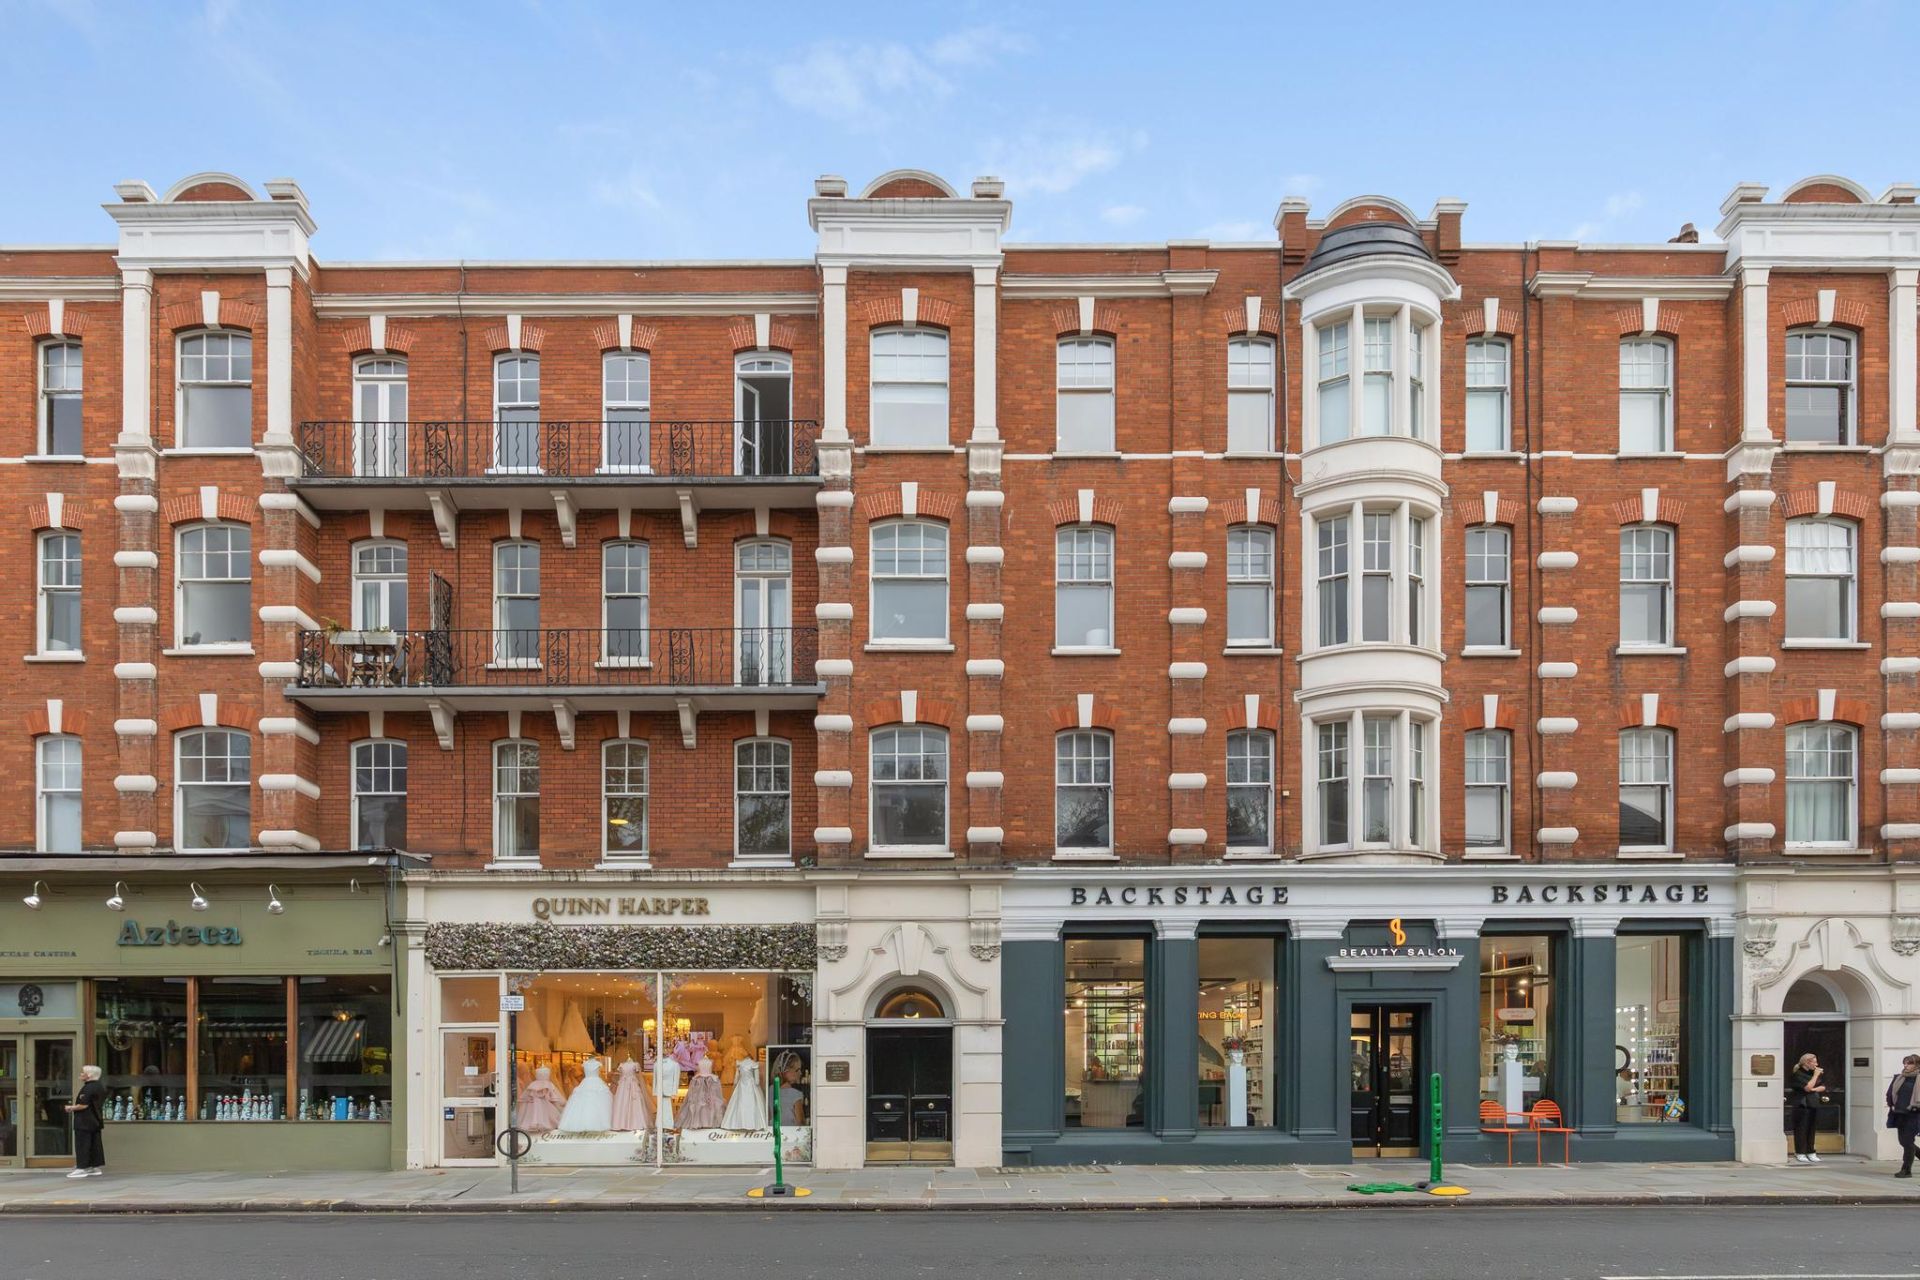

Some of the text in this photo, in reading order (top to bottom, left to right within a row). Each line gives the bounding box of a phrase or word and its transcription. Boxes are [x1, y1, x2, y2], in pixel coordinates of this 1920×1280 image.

[1071, 886, 1289, 905] BACKSTAGE
[1491, 884, 1709, 904] BACKSTAGE
[532, 897, 710, 920] QUINN HARPER
[116, 919, 243, 946] Azteca
[1339, 948, 1457, 957] BEAUTY SALON
[744, 1130, 783, 1140] Harp
